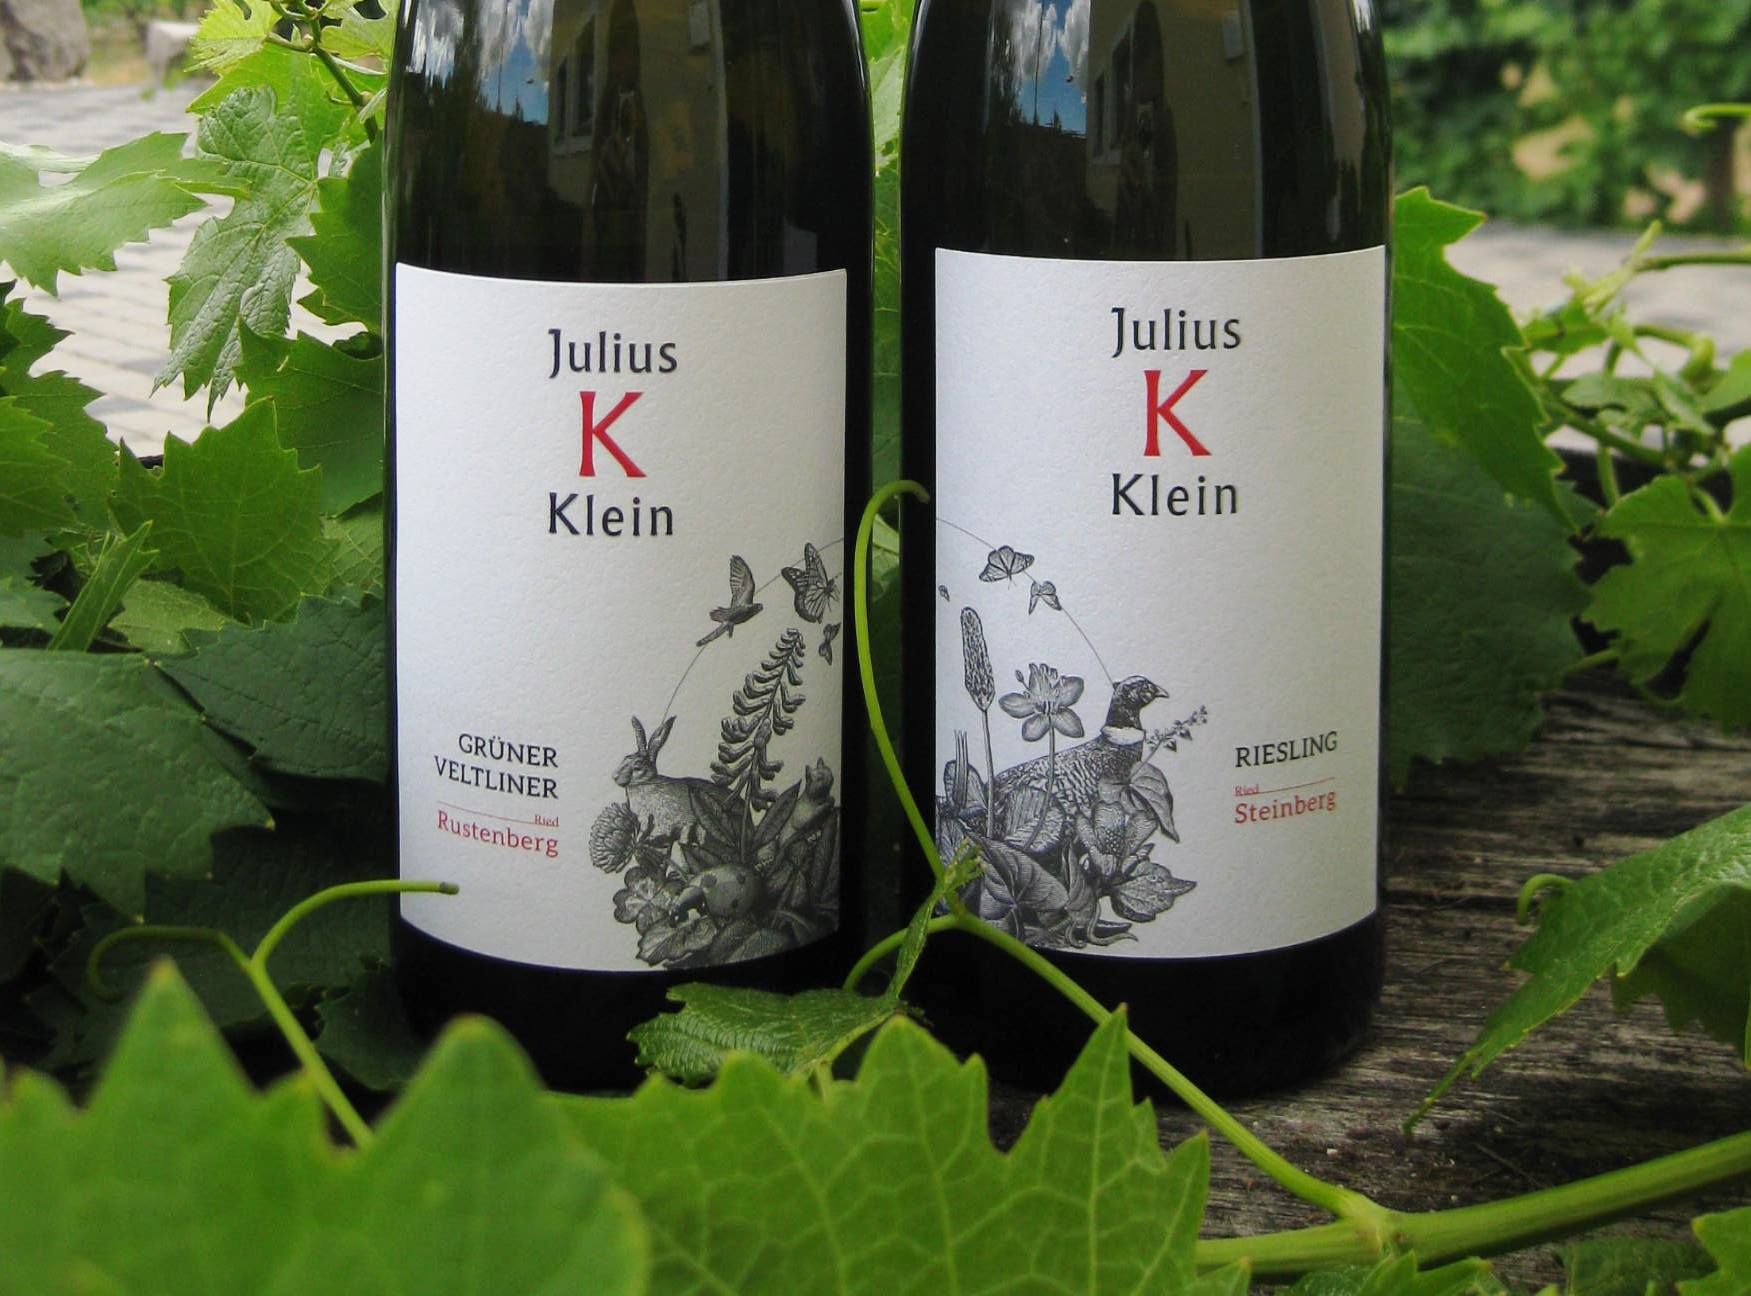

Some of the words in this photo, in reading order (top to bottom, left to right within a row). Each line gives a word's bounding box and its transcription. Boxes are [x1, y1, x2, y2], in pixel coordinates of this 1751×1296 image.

[548, 329, 677, 378] Julius
[1112, 307, 1241, 358] Julius
[579, 391, 646, 477] K
[1144, 370, 1212, 456] K
[549, 492, 674, 536] Klein
[1112, 473, 1237, 516] Klein
[459, 733, 558, 768] GRÜNER
[1235, 731, 1337, 767] RIESLING
[434, 755, 559, 799] VELTLINER
[534, 814, 559, 827] Ried
[1235, 791, 1336, 823] Steinberg
[438, 810, 559, 857] Rustenberg
